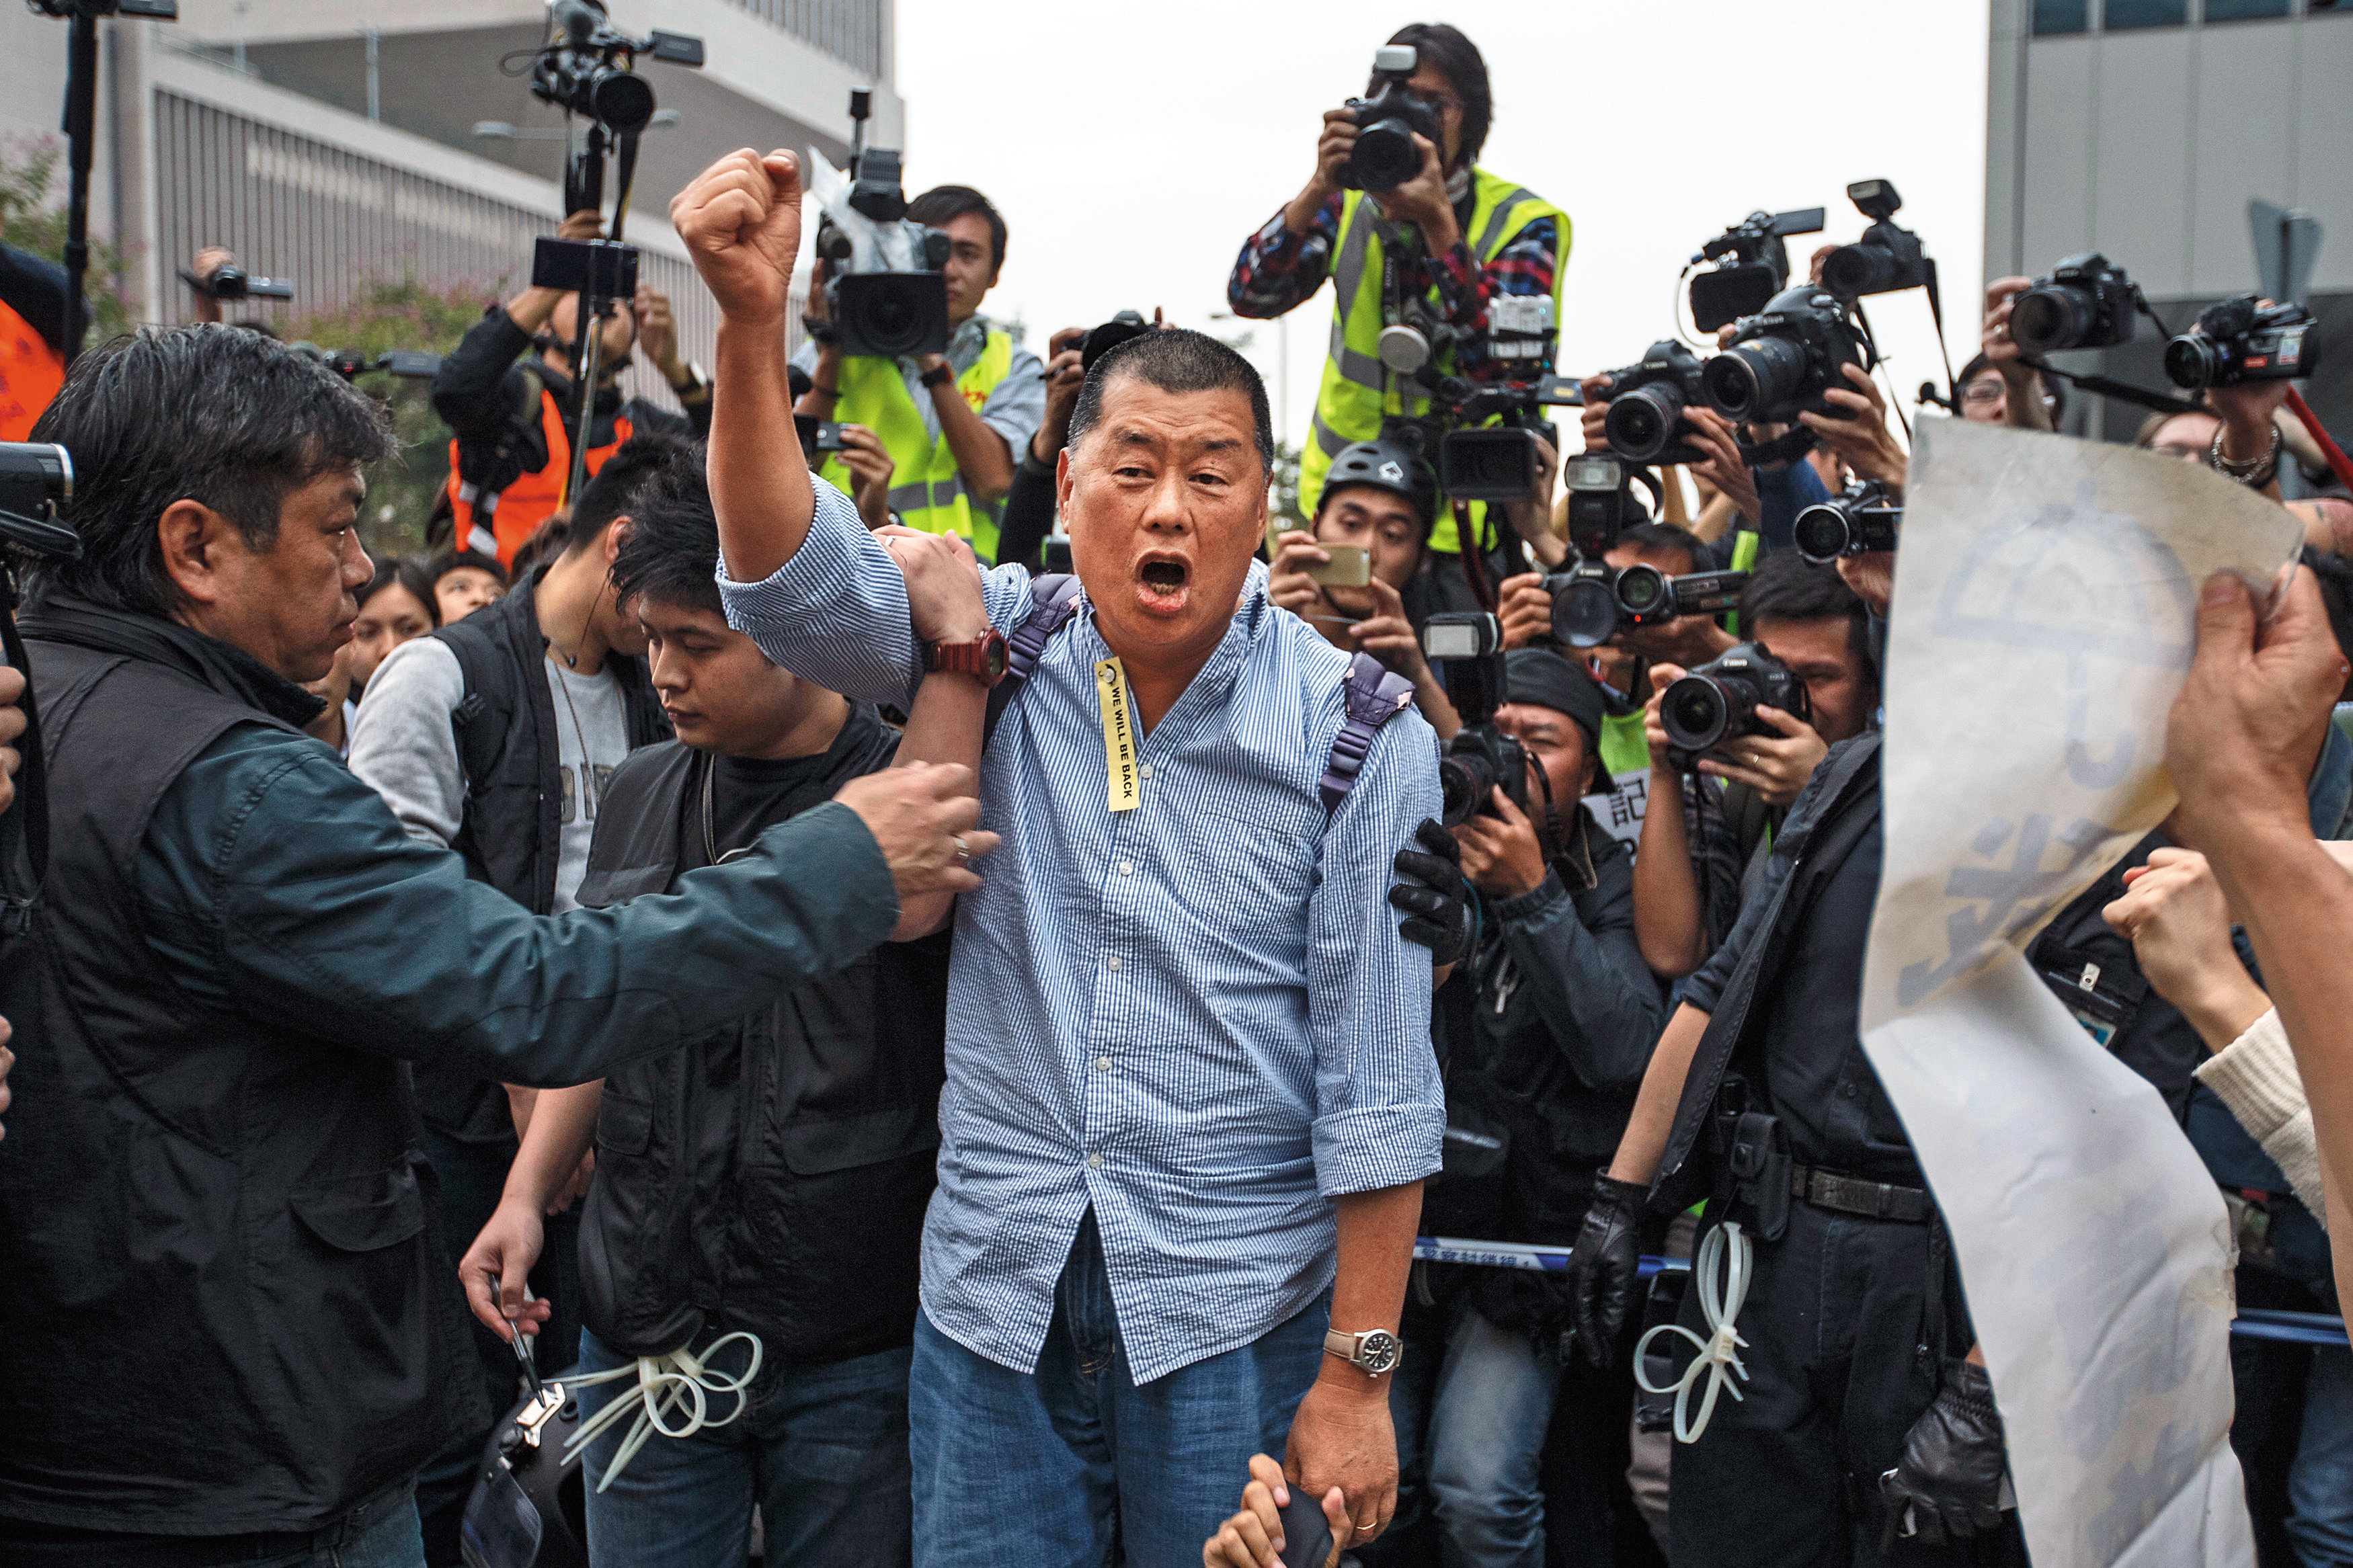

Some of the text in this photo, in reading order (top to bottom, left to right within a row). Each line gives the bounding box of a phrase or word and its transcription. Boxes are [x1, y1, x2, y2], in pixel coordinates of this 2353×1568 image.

[1722, 658, 1748, 667] Canon
[1112, 686, 1132, 799] WE WILL BE BACK
